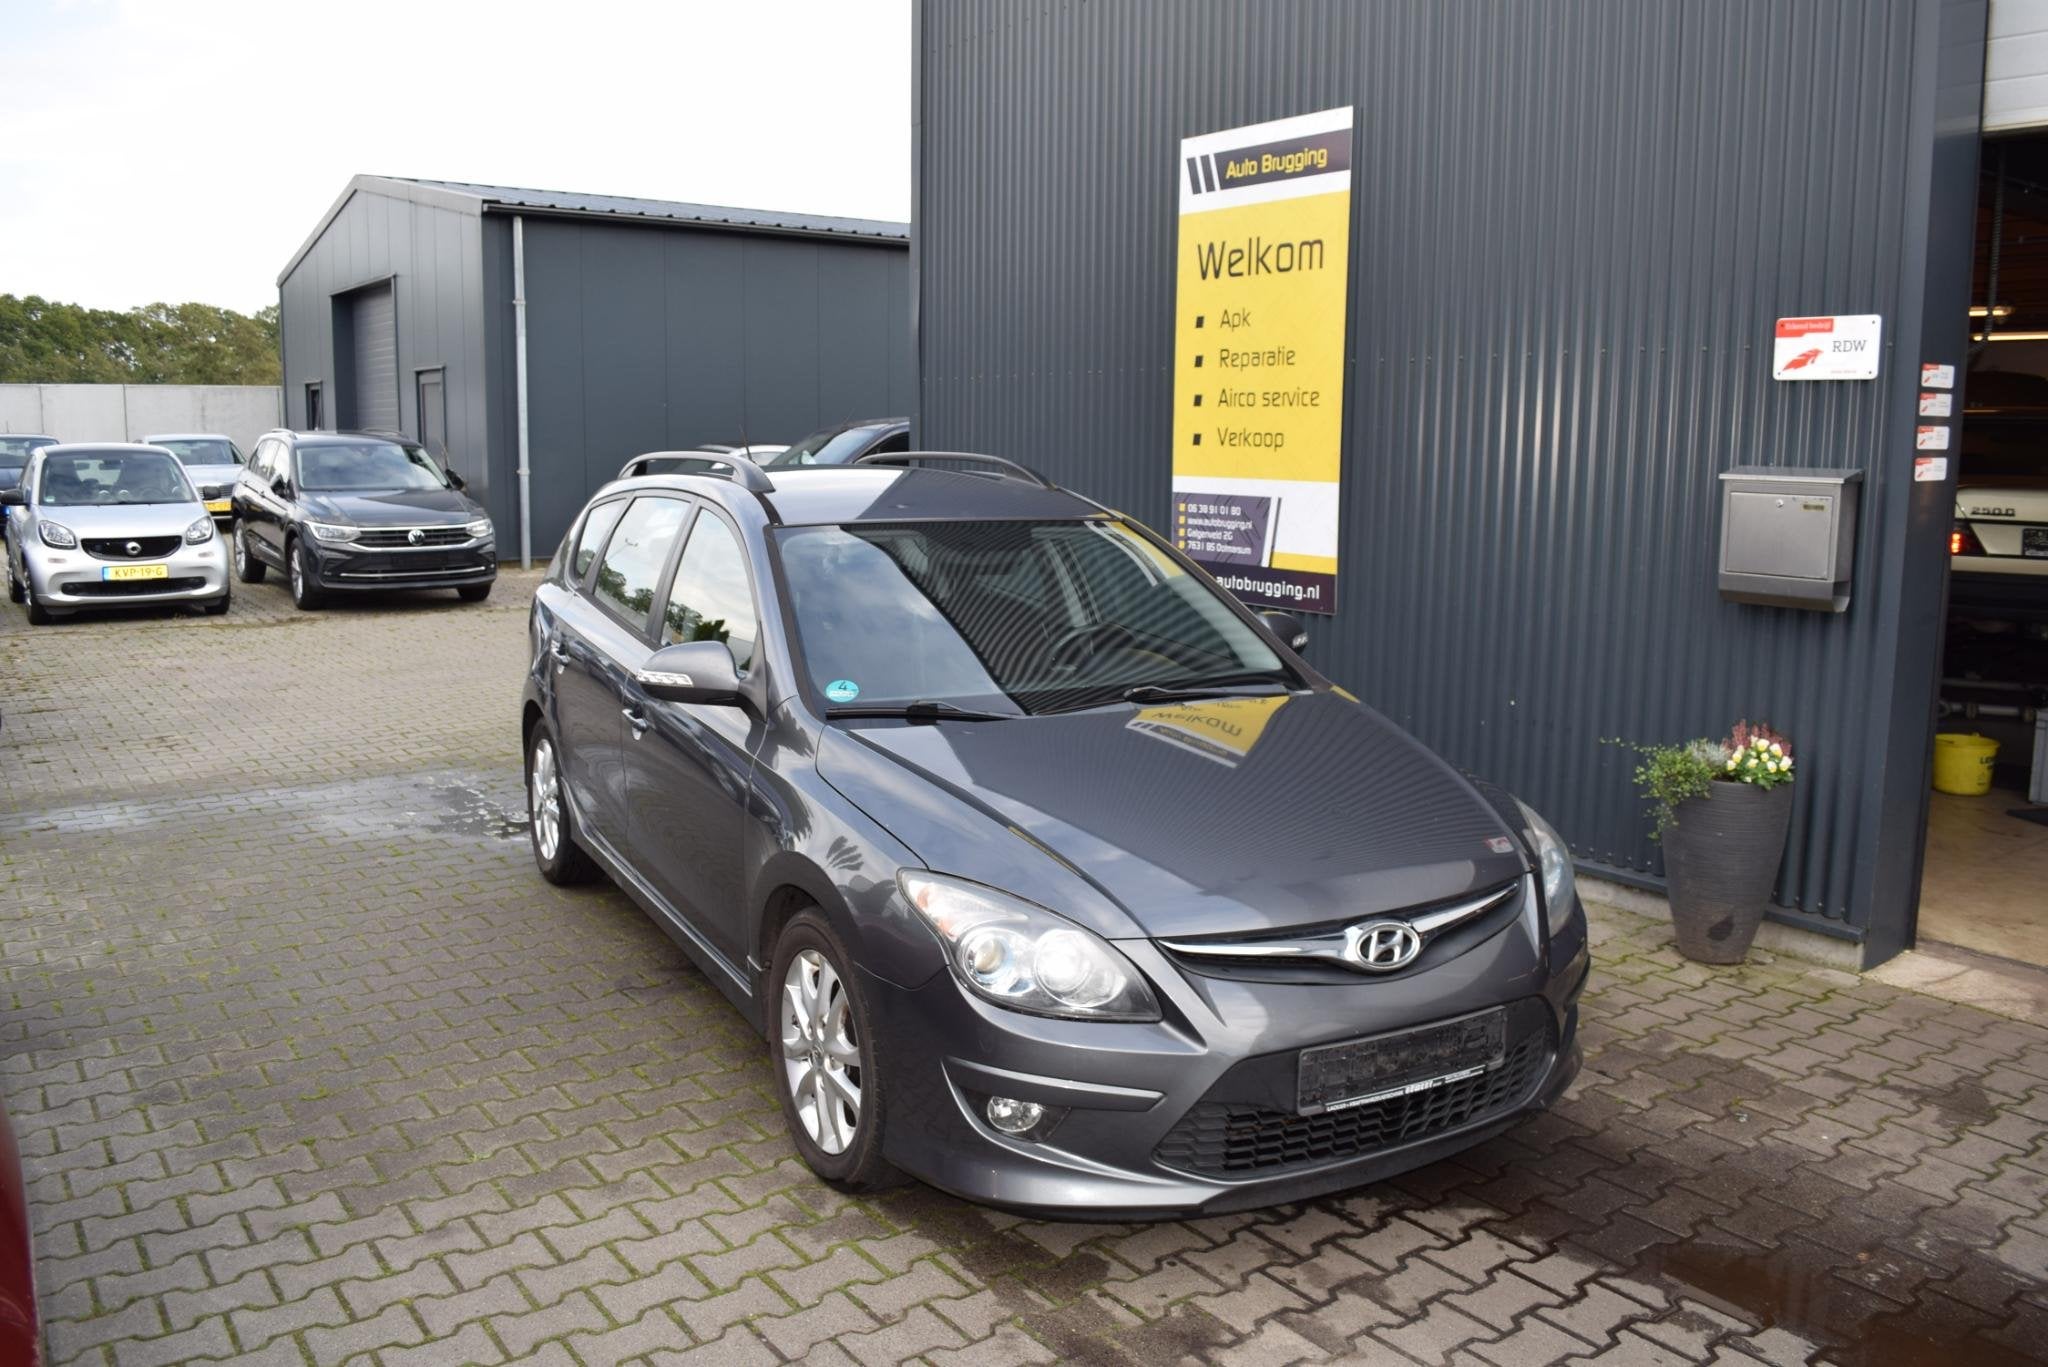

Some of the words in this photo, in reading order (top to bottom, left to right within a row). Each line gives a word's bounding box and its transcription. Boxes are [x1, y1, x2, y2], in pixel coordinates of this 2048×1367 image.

[1225, 158, 1257, 179] Auto
[1261, 147, 1327, 173] Brugging
[1197, 236, 1323, 280] Welkom
[1219, 307, 1251, 332] Apk
[1219, 345, 1296, 372] Reparatie
[1832, 339, 1867, 353] RDW
[1218, 388, 1256, 408] Airco
[1262, 386, 1320, 407] service
[1217, 427, 1284, 452] Verkoop
[1187, 503, 1197, 513] 06
[1209, 505, 1218, 515] 91
[1220, 506, 1229, 516] 01
[114, 567, 163, 578] KVP-19-G
[1216, 575, 1320, 600] autobrugging.nl
[838, 681, 847, 690] 4
